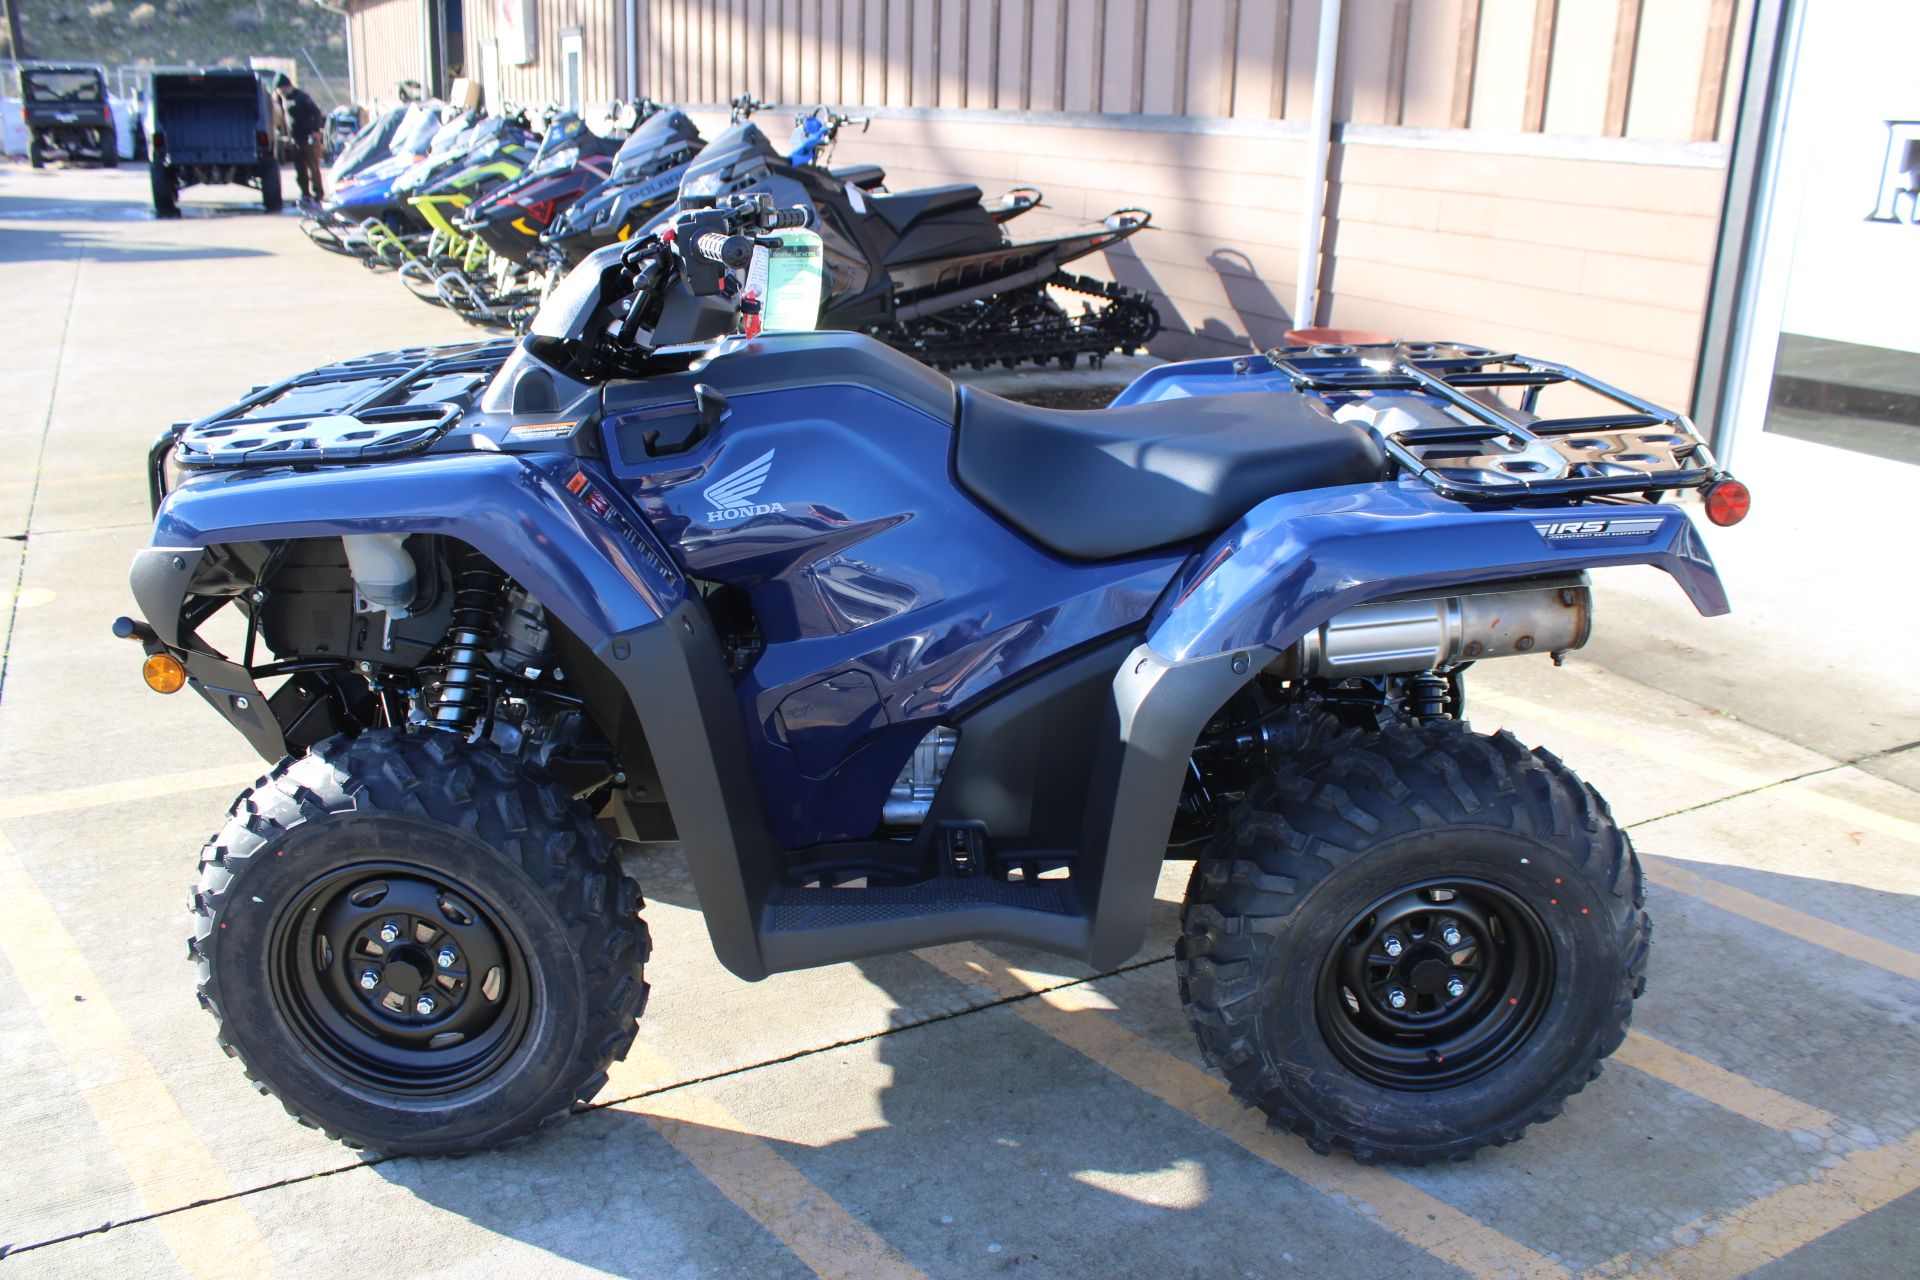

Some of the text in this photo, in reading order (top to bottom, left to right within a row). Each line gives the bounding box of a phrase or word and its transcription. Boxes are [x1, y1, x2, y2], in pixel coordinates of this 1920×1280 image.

[629, 171, 684, 201] POLARI
[706, 502, 787, 523] HONDA
[1548, 520, 1607, 535] IRS
